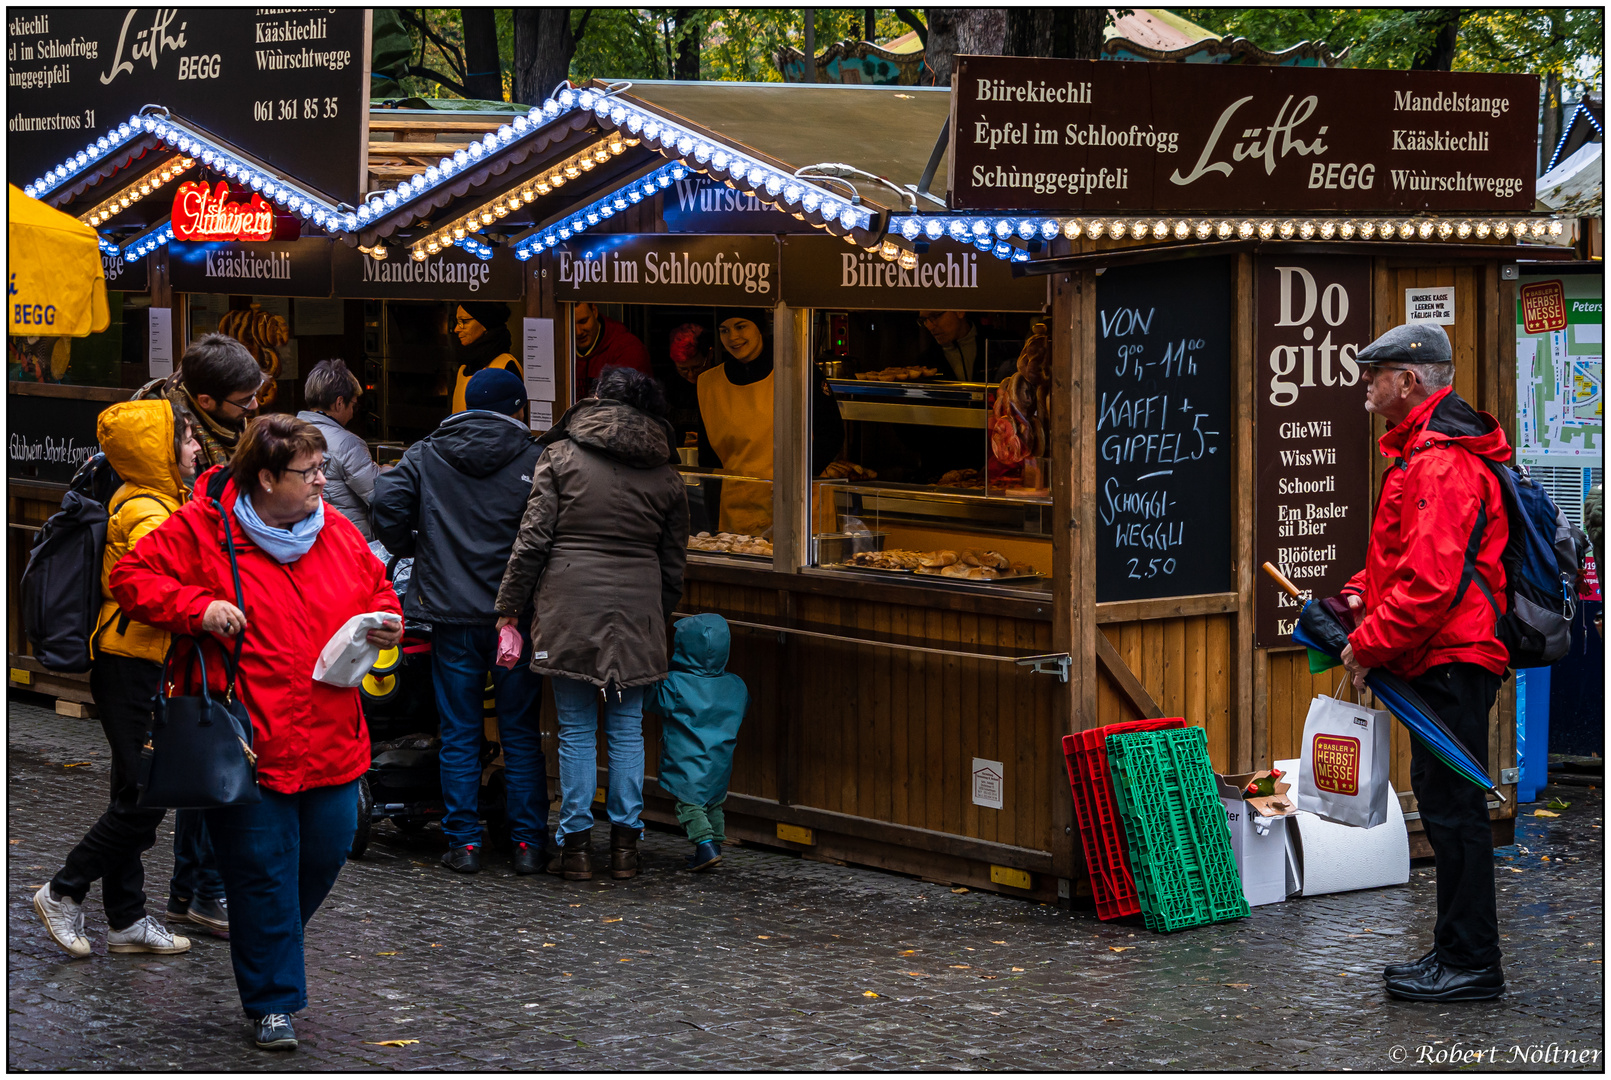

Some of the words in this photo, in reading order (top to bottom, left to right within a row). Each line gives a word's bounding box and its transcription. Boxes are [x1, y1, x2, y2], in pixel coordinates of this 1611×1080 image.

[255, 18, 327, 43] Kääskiechli
[21, 42, 34, 60] im
[37, 36, 98, 60] Schloofrògg
[100, 9, 188, 85] Lüthi
[255, 47, 351, 70] Wùùrschtwegge
[178, 54, 222, 80] BEGG
[976, 78, 1092, 104] Biirekiechli
[253, 100, 273, 121] 061
[277, 99, 298, 120] 361
[303, 98, 318, 119] 85
[322, 97, 338, 118] 35
[1393, 90, 1510, 118] Mandelstange
[84, 109, 96, 128] 31
[973, 114, 1028, 150] Èpfel
[1033, 122, 1059, 145] im
[1065, 123, 1179, 153] Schloofrògg
[1169, 95, 1329, 186] Lüthi
[1392, 130, 1490, 152] Kääskiechli
[971, 165, 1128, 195] Schùnggegipfeli
[1308, 162, 1376, 190] BEGG
[1390, 169, 1523, 198] Wùùrschtwegge
[205, 250, 292, 280] Kääskiechli
[362, 254, 490, 292] Mandelstange
[558, 243, 608, 290] Èpfel
[613, 251, 639, 284] im
[645, 251, 771, 294] Schloofrògg
[840, 252, 979, 288] Biirekiechli
[1274, 266, 1350, 327] Do
[1411, 294, 1432, 302] UNSERE
[1432, 293, 1449, 302] KASSE
[1526, 294, 1559, 309] HERBST
[1530, 288, 1553, 297] BASLER
[14, 304, 56, 325] BEGG
[1100, 307, 1155, 338] VON
[1528, 305, 1561, 321] MESSE
[1269, 326, 1360, 407] gits
[1097, 390, 1168, 432] KAFFI
[1279, 421, 1332, 439] GlieWii
[1101, 432, 1190, 465] GIPFEL
[1279, 448, 1336, 467] WissWii
[1278, 475, 1335, 494] Schoorli
[1278, 504, 1301, 521] Em
[1305, 502, 1348, 520] Basler
[1115, 521, 1184, 551] WEGGLI
[1278, 520, 1294, 537] sii
[1298, 519, 1327, 536] Bier
[1277, 544, 1336, 564] Blööterli
[1126, 557, 1177, 579] 2.50
[1278, 562, 1328, 579] Wasser
[1317, 750, 1354, 767] HERBST
[1323, 743, 1349, 752] BASLER
[1318, 762, 1353, 781] MESSE
